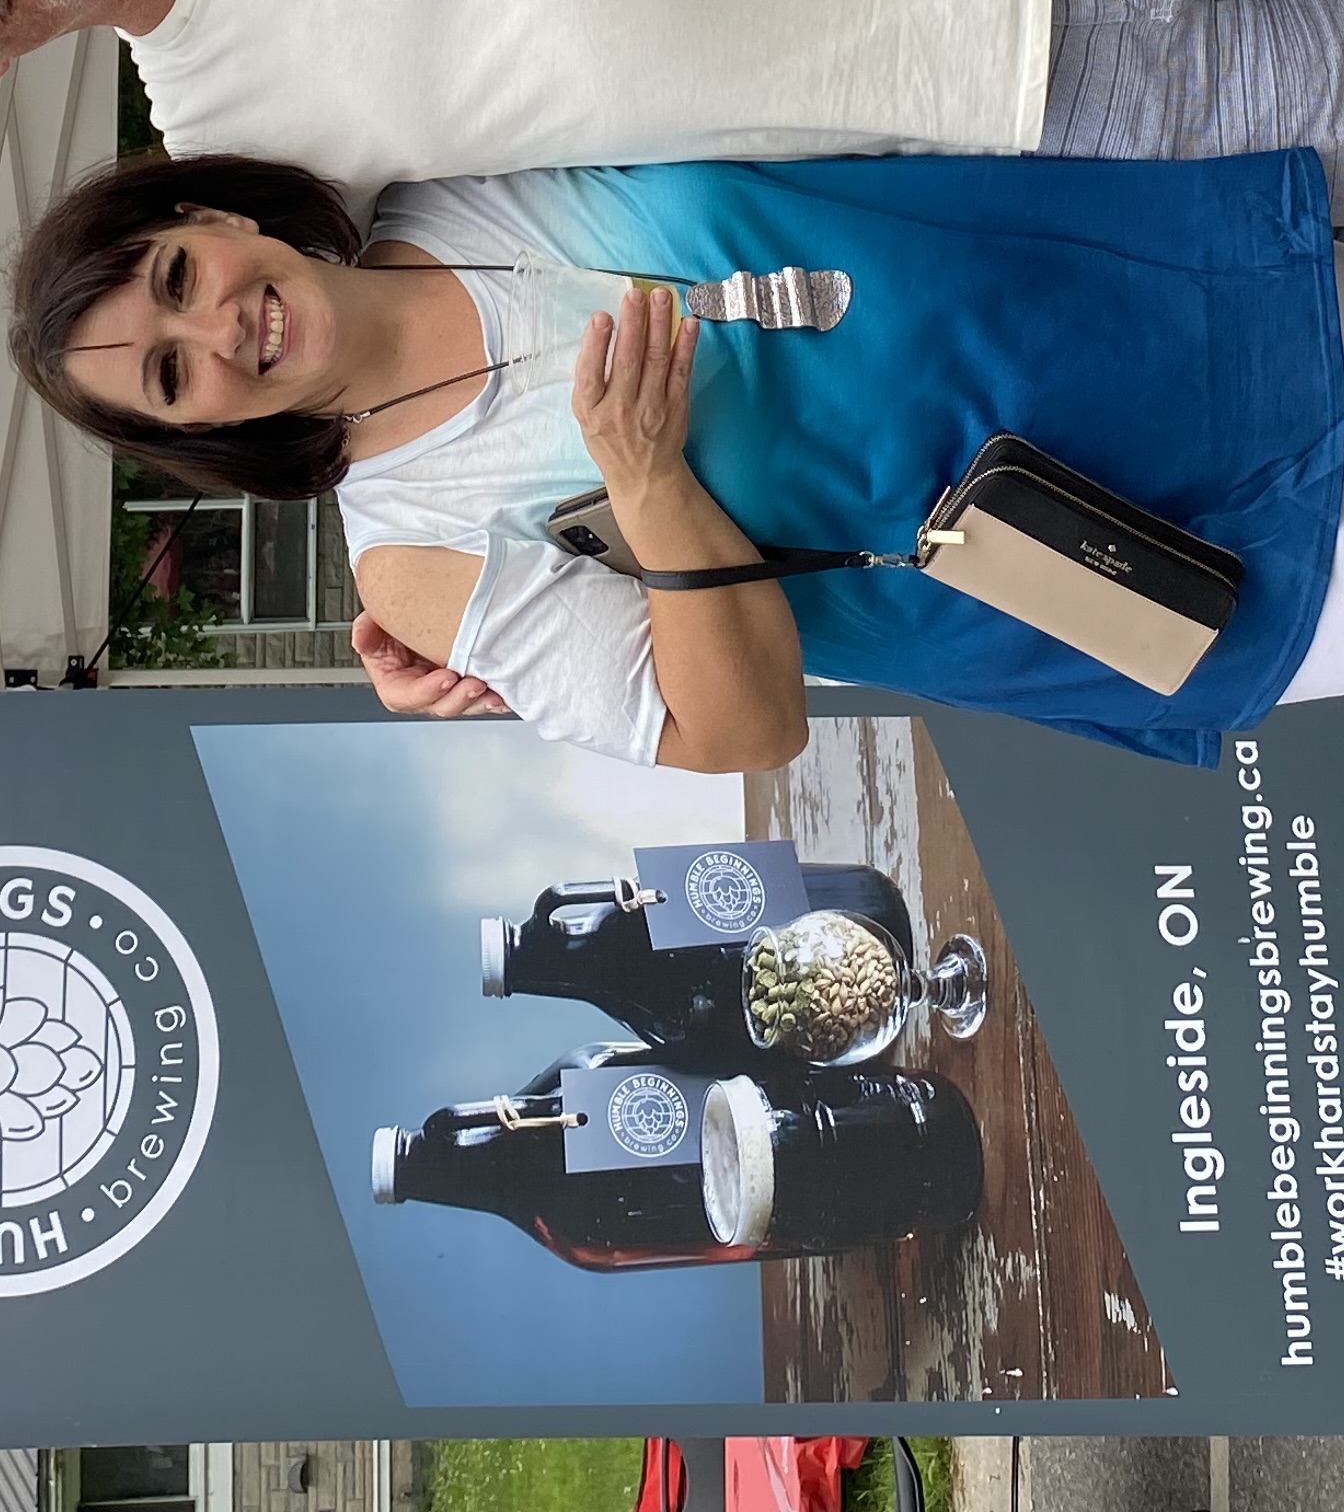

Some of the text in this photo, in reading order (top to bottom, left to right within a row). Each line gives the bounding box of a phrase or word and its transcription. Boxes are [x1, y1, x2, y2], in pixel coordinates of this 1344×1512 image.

[690, 854, 762, 909] HUMBLE BEGINNINGS
[100, 930, 187, 1209] brewing co
[612, 1076, 684, 1132] HUMBLE BEGINNINGS
[1154, 865, 1225, 1232] Ingleside, ON
[1235, 740, 1314, 1366] humblebeginningsbrewing.ca
